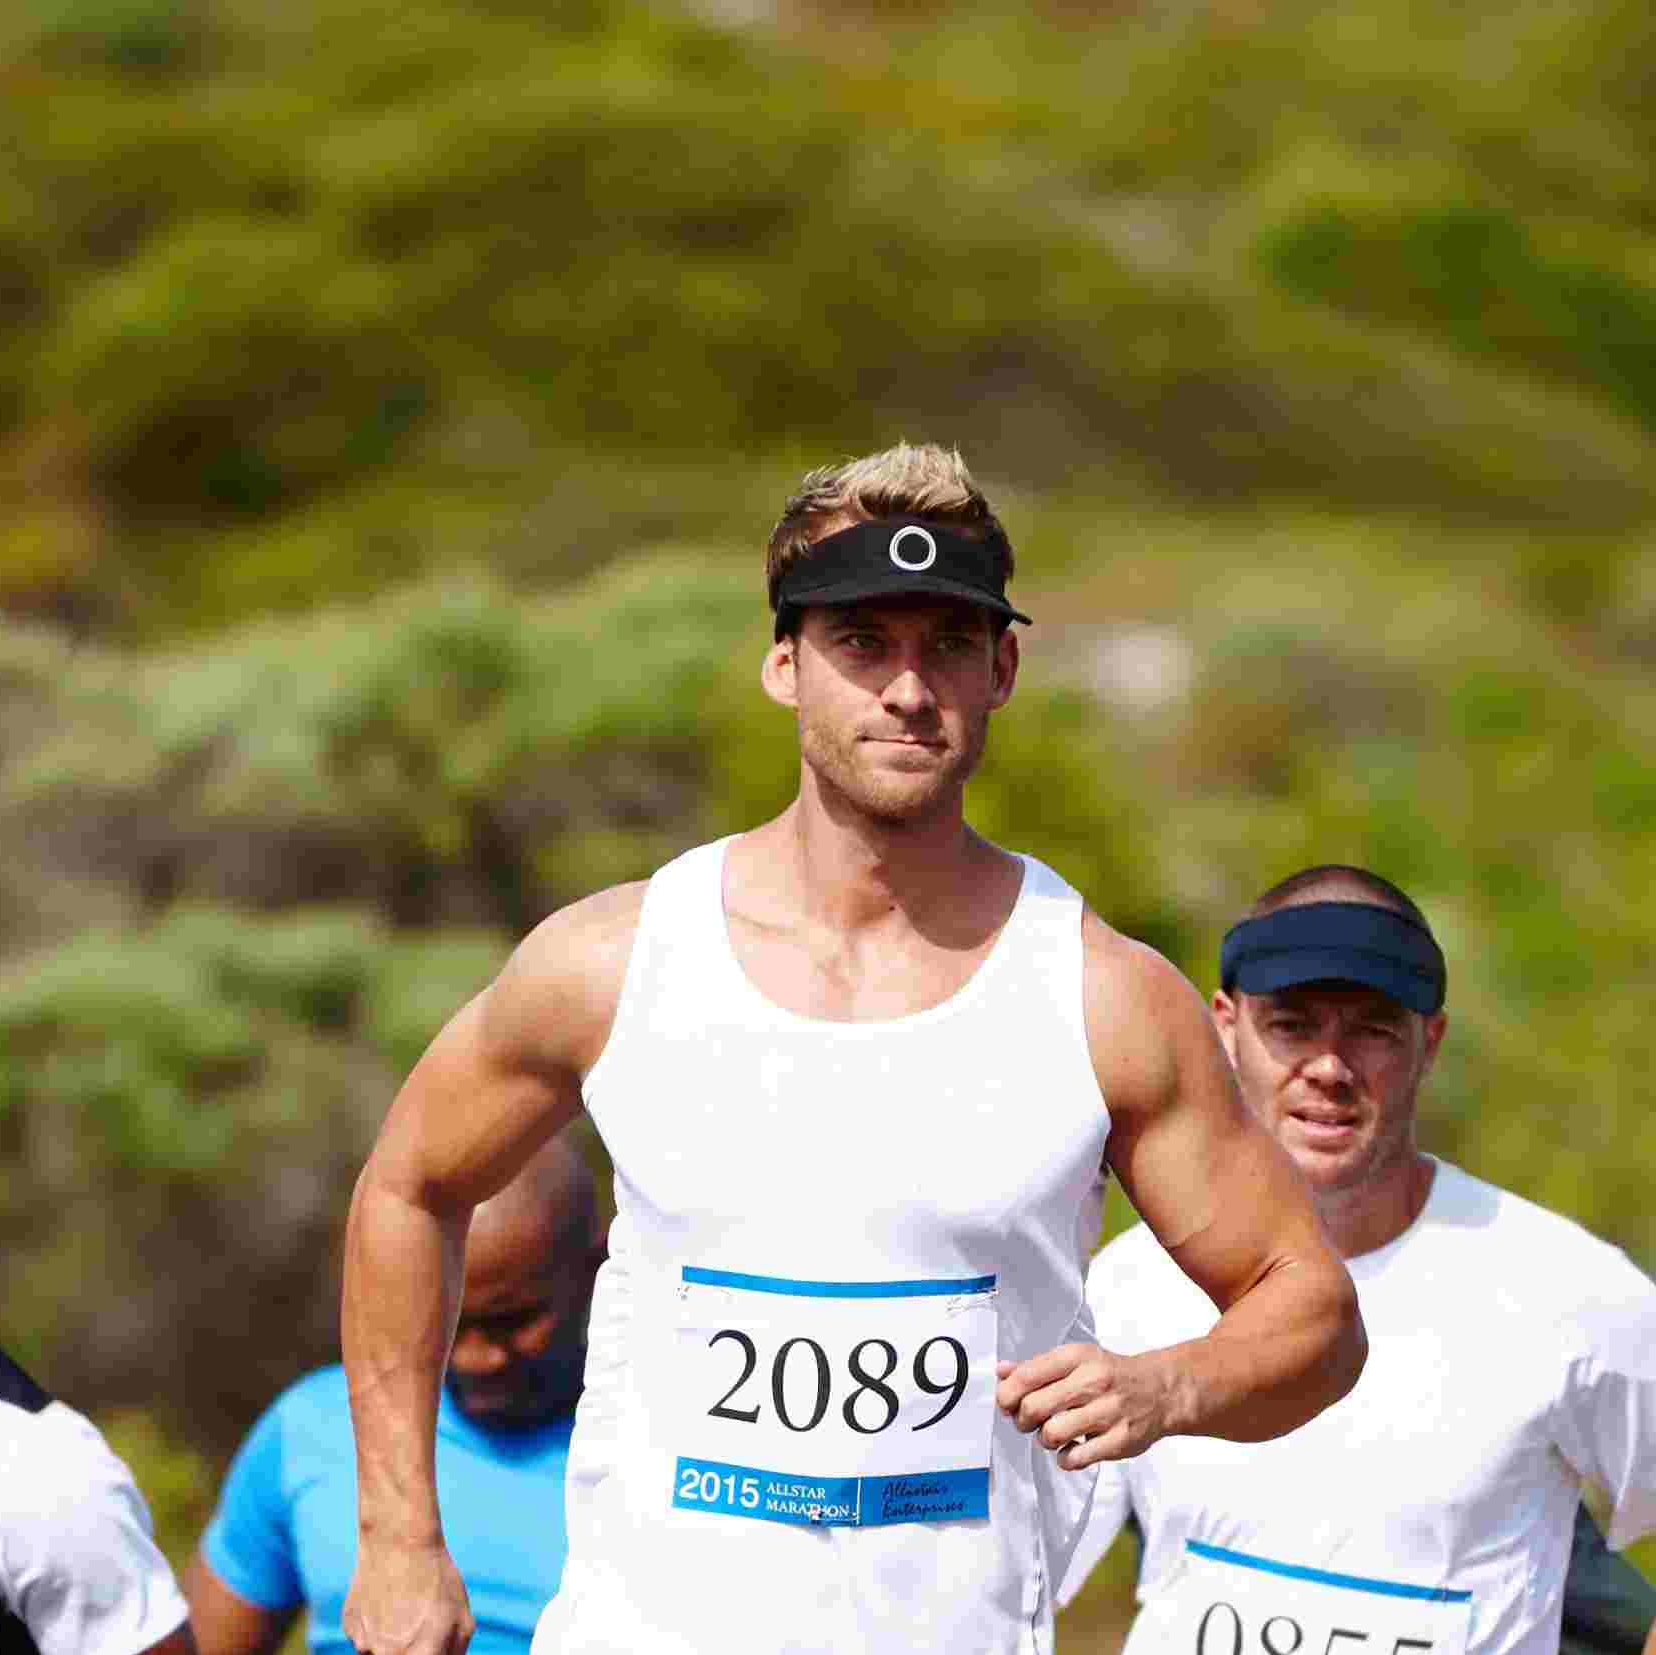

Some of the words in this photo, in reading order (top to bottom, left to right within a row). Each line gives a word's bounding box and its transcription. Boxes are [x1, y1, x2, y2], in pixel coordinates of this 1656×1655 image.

[707, 1329, 969, 1434] 2089
[679, 1468, 760, 1508] 2015
[766, 1482, 825, 1499] ALLSTAR
[766, 1499, 850, 1517] MARATHON
